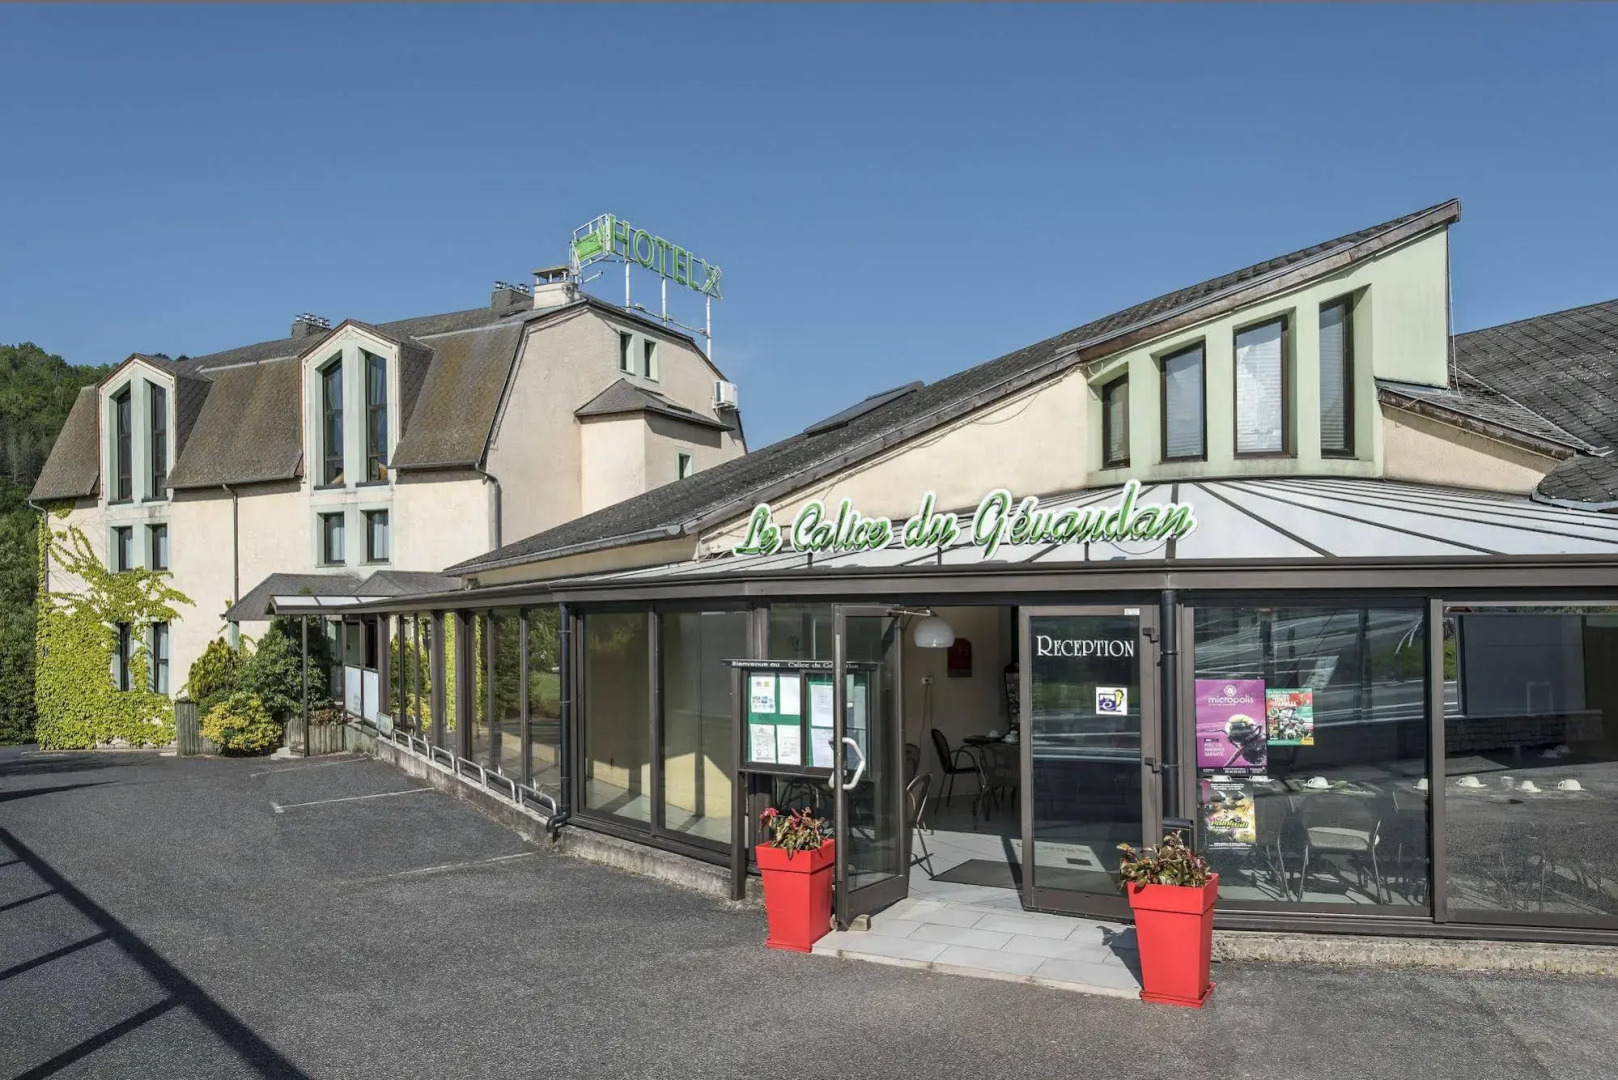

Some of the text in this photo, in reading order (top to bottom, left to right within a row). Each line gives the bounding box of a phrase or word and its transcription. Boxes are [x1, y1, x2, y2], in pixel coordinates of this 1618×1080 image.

[608, 213, 699, 290] HOTEL
[734, 479, 1197, 560] Le Calice du Gévaudan
[788, 661, 810, 669] Calice
[1208, 695, 1254, 705] micropolis
